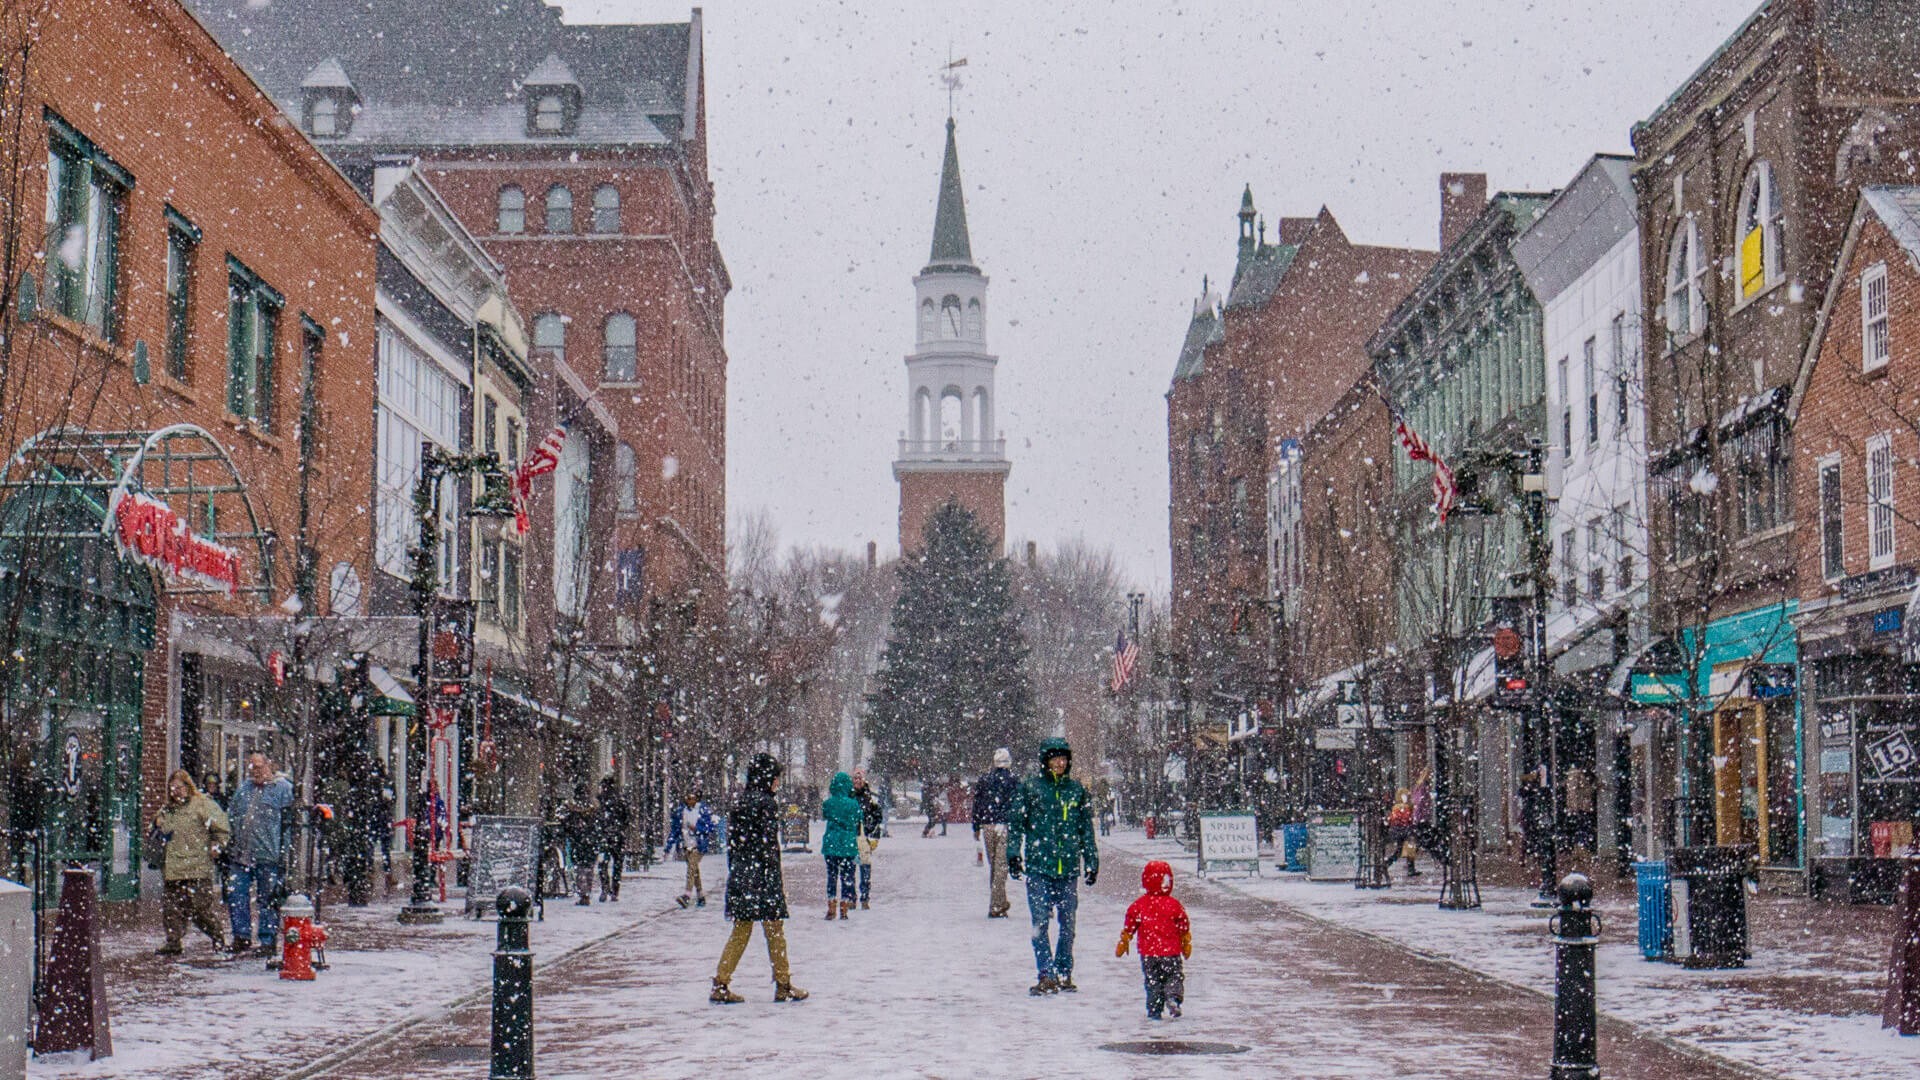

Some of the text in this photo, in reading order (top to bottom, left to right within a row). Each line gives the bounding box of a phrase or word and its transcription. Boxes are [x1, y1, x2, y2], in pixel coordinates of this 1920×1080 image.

[1874, 737, 1910, 772] 15
[1210, 822, 1247, 831] SPIRIT
[1206, 833, 1253, 842] TASTING
[1220, 845, 1252, 854] SALES
